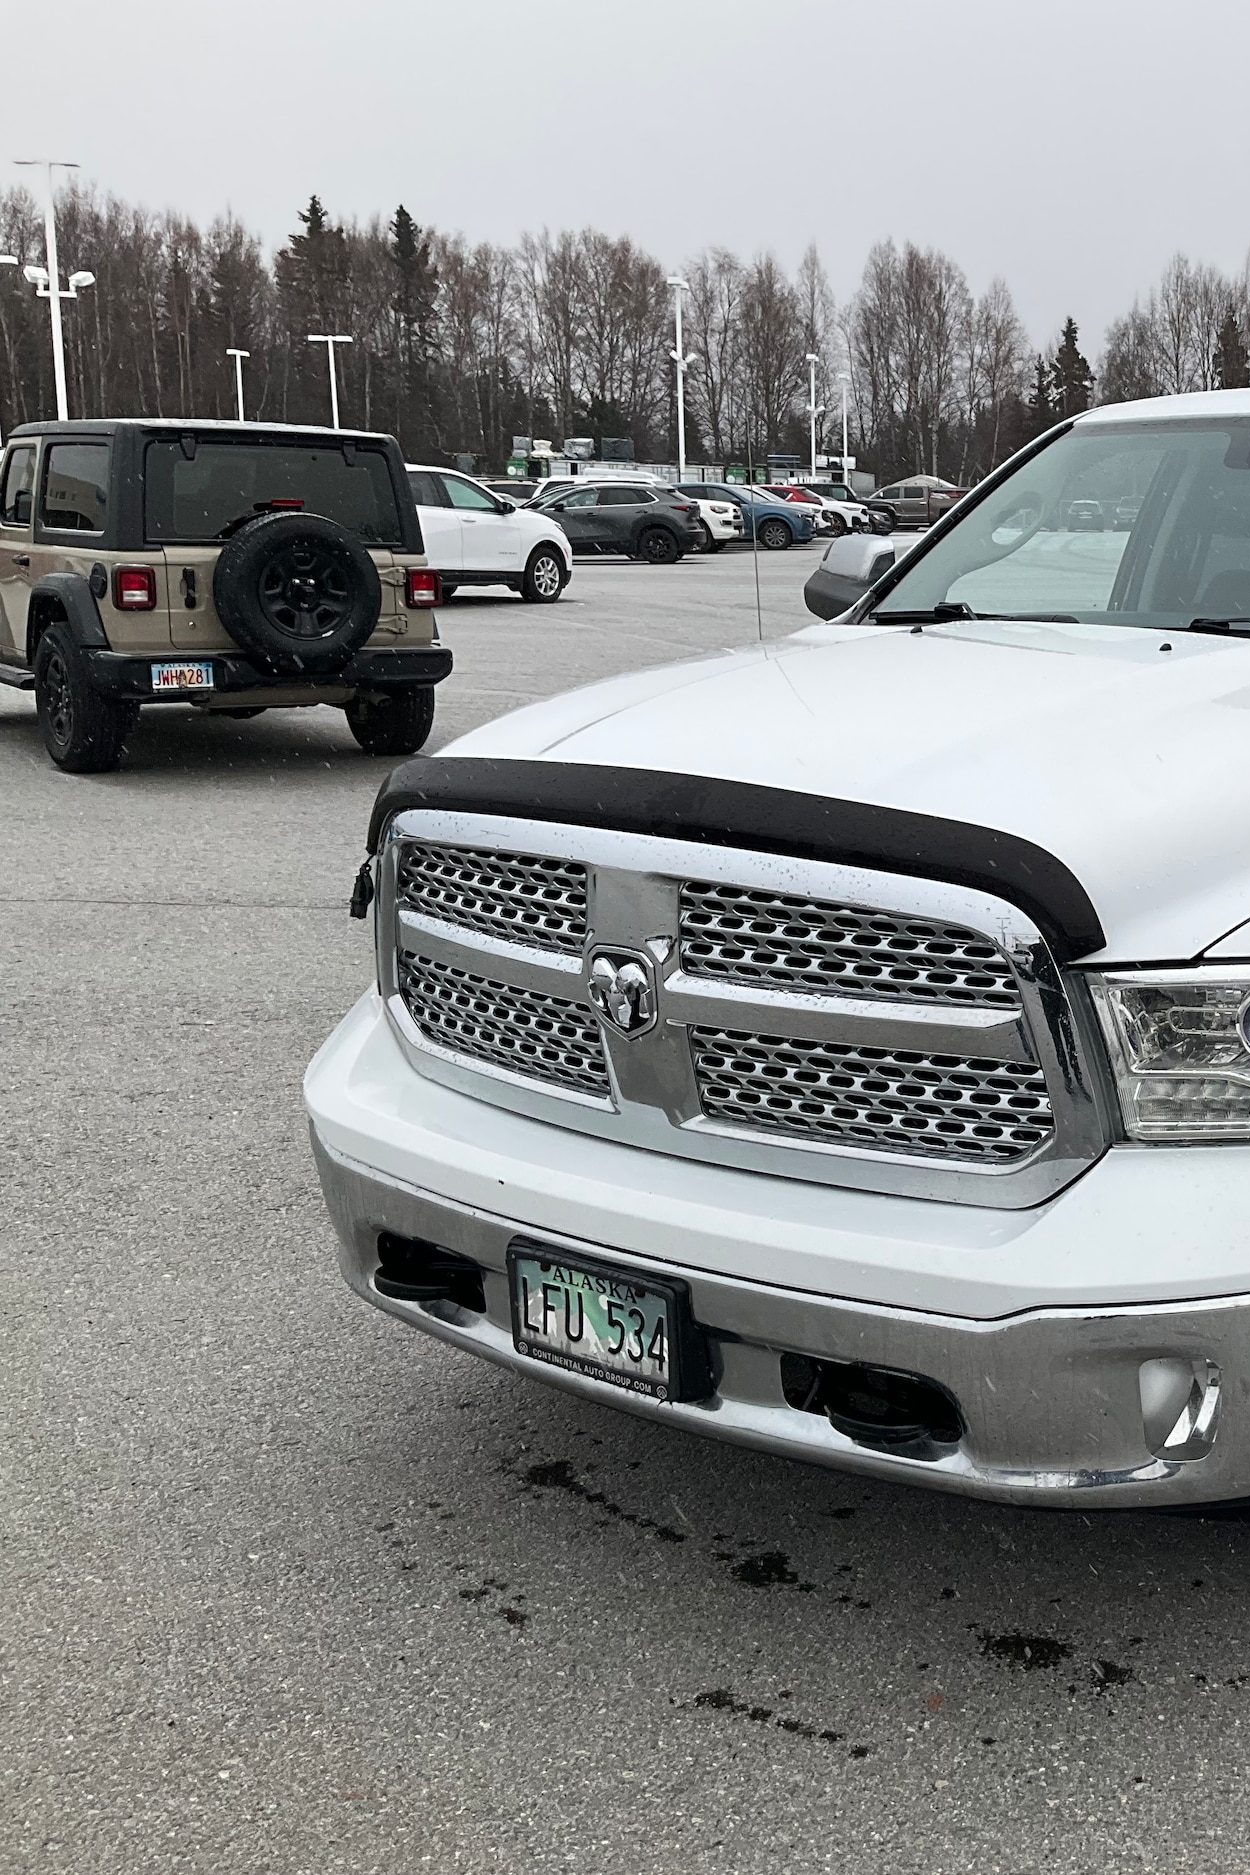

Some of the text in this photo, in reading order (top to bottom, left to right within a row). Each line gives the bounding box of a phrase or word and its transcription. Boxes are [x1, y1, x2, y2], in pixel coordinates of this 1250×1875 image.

[553, 1266, 637, 1304] ALASKA
[522, 1276, 666, 1372] LFU 534
[532, 1347, 582, 1372] CONTINENTAL
[583, 1364, 604, 1378] AUTO
